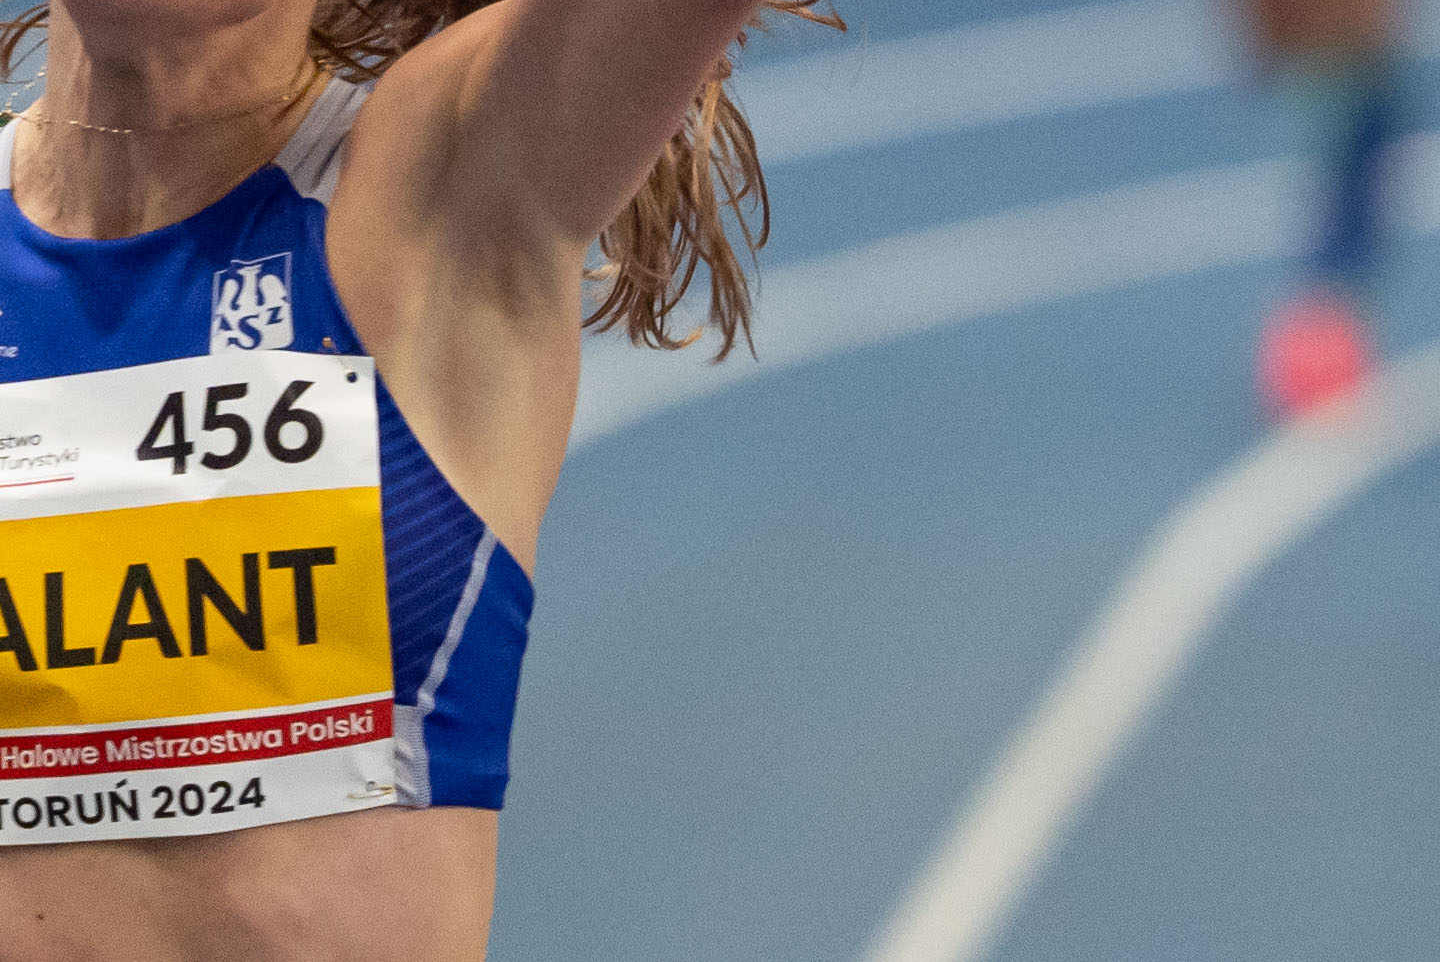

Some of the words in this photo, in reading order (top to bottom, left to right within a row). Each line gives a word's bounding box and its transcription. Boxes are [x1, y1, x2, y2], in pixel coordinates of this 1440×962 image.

[135, 380, 324, 475] 456
[0, 742, 100, 771] Halowe
[105, 726, 285, 763] Mistrzostwa
[290, 708, 375, 745] Polski
[151, 776, 266, 820] 2024
